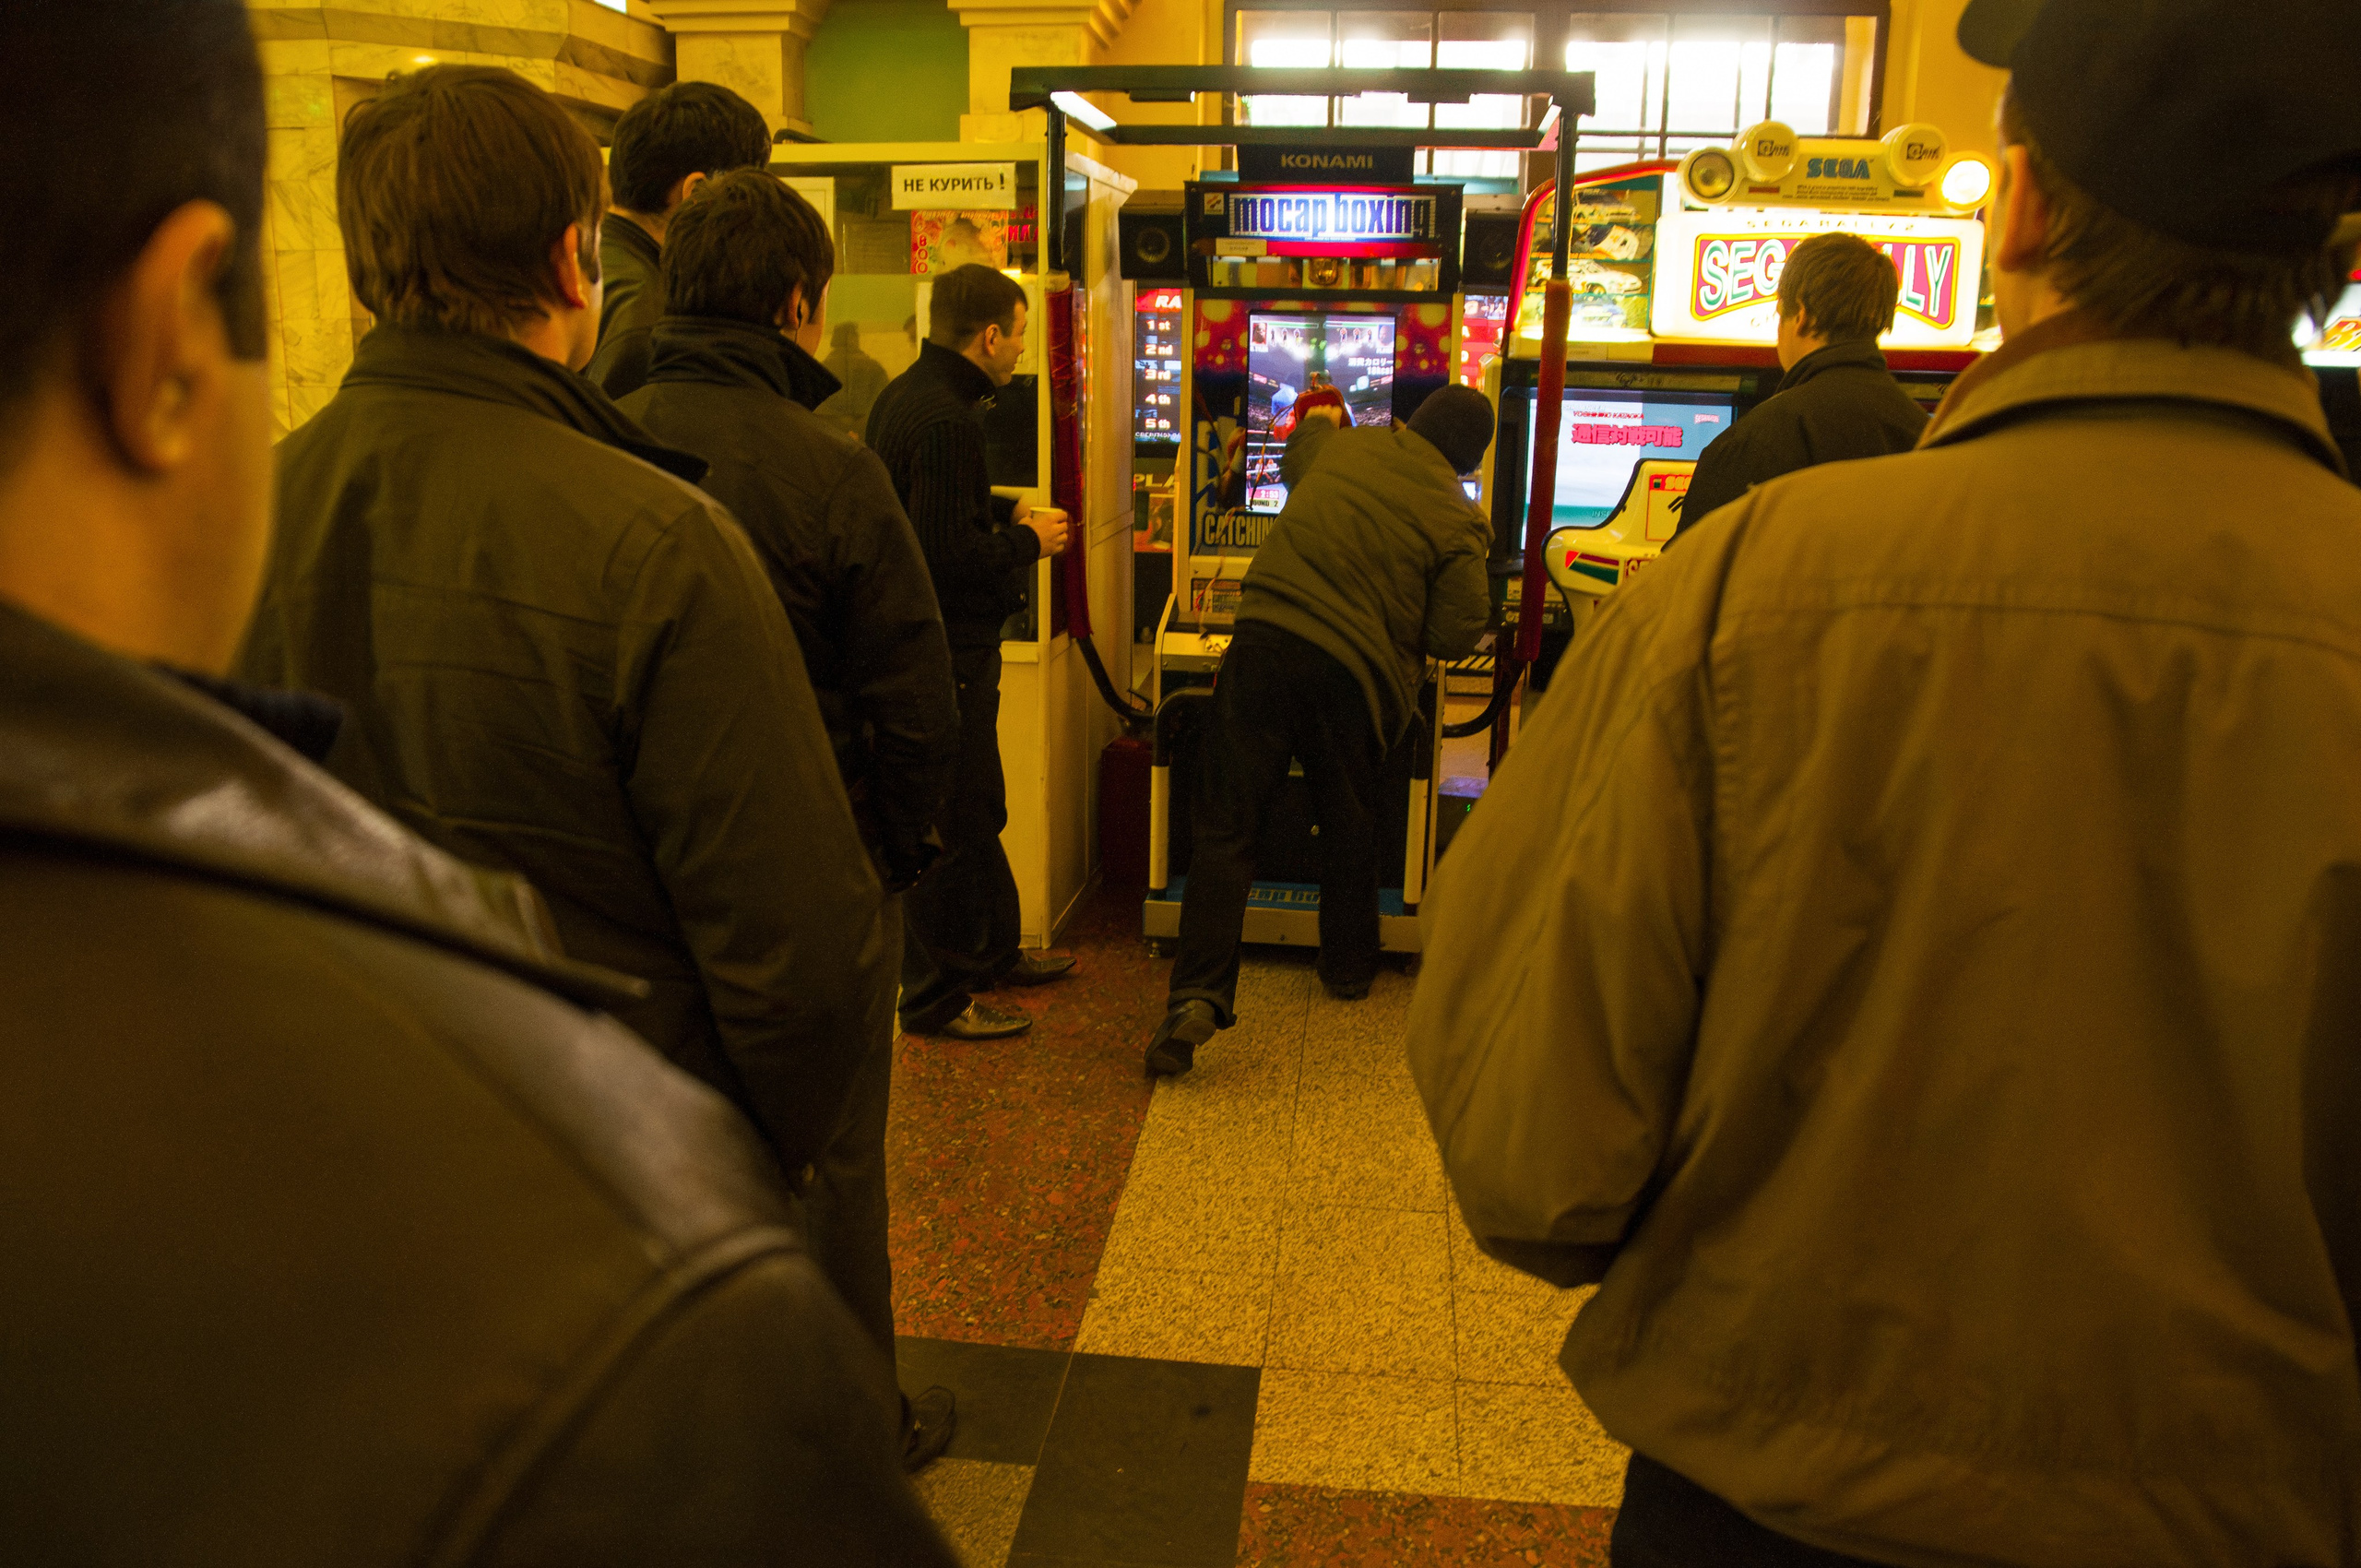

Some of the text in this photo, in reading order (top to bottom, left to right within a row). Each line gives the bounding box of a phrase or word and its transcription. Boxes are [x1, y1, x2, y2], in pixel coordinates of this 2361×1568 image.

[1281, 153, 1374, 169] KONAMI
[1806, 158, 1870, 179] SEGA
[904, 178, 924, 192] НЕ
[930, 177, 994, 191] КУРИТЬ
[1233, 190, 1429, 238] mocap boxing
